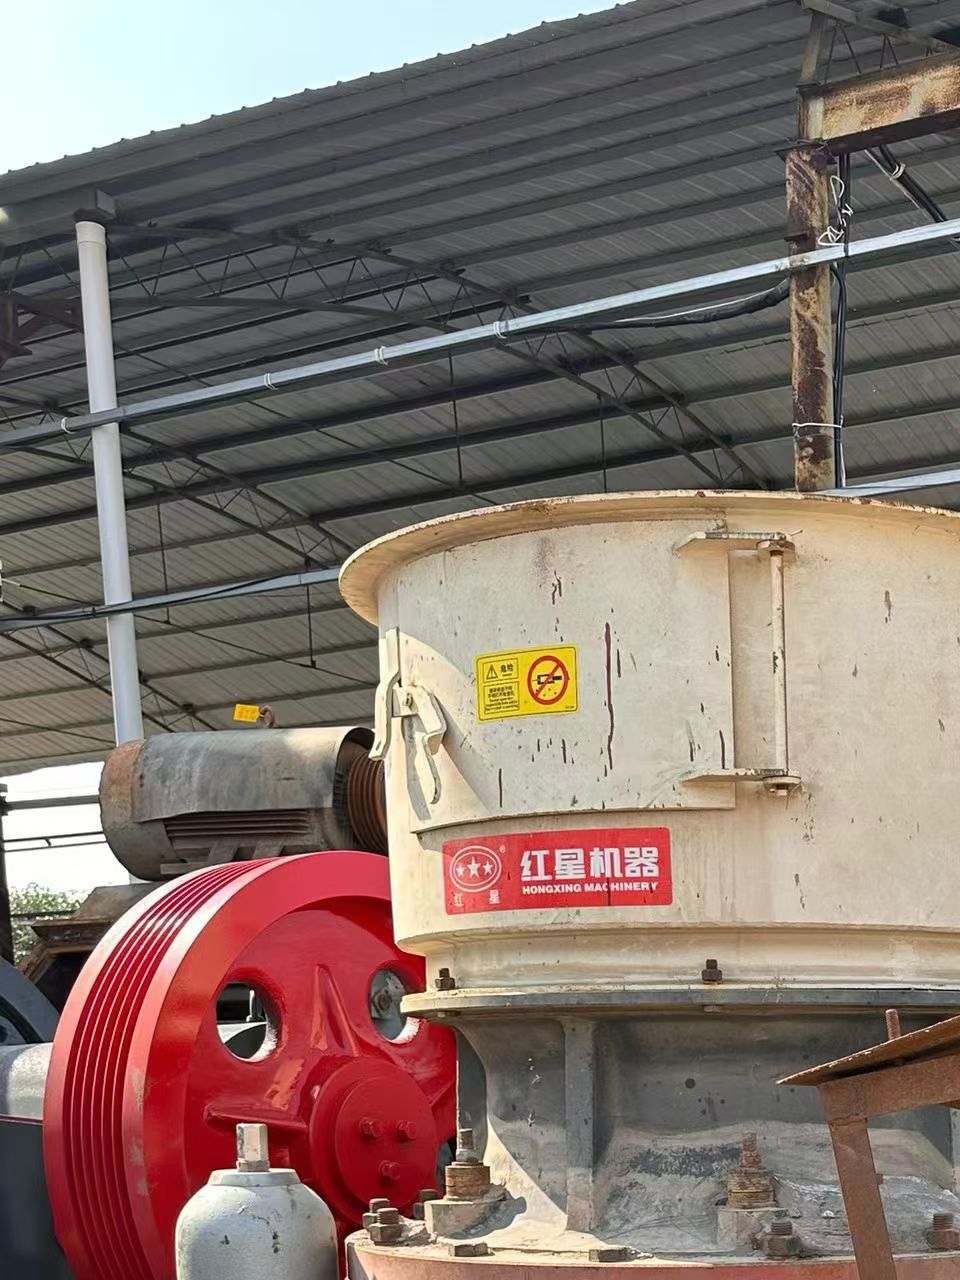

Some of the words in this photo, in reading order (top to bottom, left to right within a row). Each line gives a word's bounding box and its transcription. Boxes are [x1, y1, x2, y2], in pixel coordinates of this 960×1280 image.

[520, 847, 660, 881] 红星机器
[522, 883, 582, 895] HONGXING
[584, 881, 659, 893] MACHINERY
